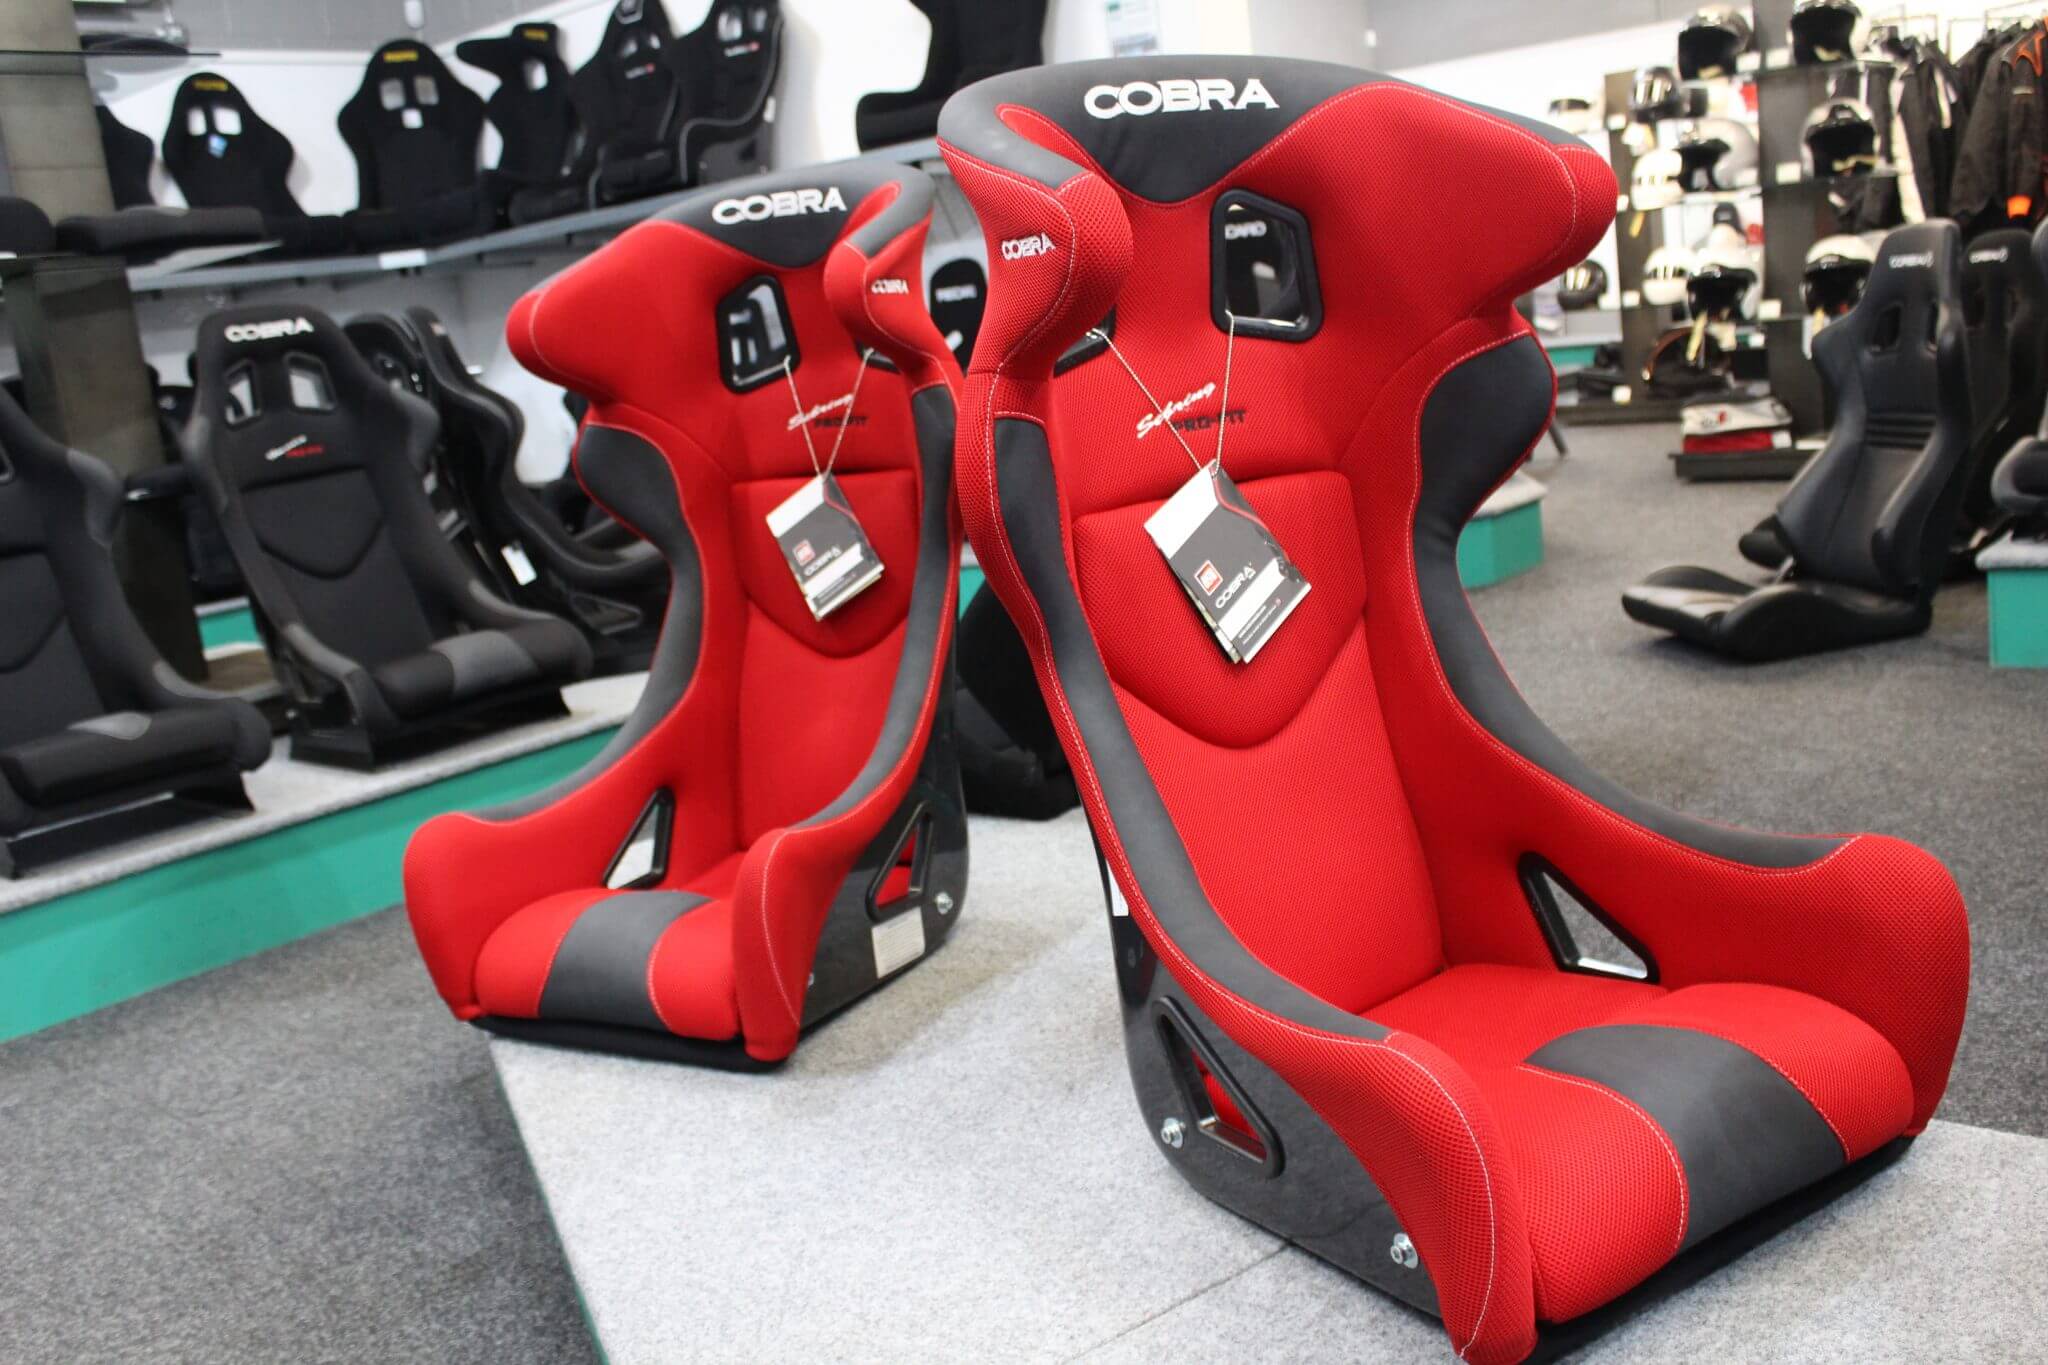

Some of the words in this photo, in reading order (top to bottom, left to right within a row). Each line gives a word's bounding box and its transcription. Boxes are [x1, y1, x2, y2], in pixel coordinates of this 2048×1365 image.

[1083, 78, 1280, 120] COBRA
[711, 186, 848, 225] COBRA
[1001, 231, 1057, 261] COBRA
[871, 279, 910, 295] COBRA
[224, 316, 315, 343] COBRA
[1215, 564, 1257, 609] COBRA
